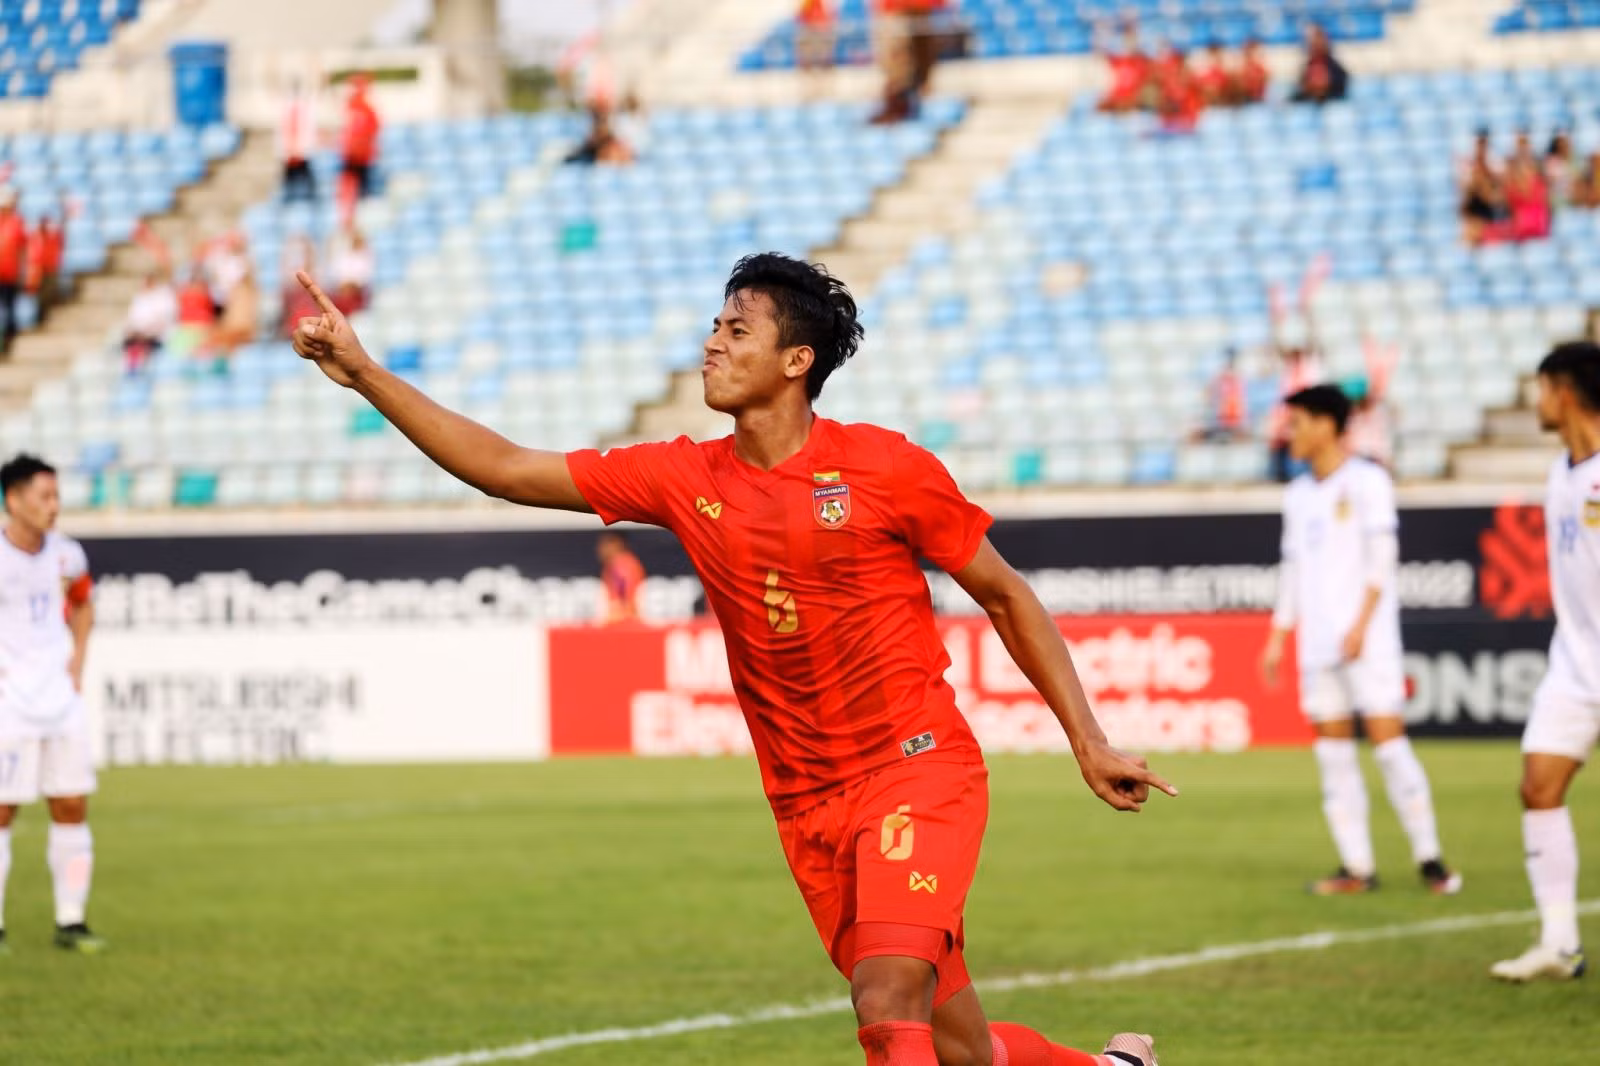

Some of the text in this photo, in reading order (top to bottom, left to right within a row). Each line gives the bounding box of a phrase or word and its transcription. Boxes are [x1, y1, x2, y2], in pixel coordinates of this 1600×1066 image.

[814, 486, 847, 497] MYANMAR
[92, 565, 699, 627] #BeTheGameChaner
[763, 569, 798, 634] 6
[880, 804, 914, 861] 6
